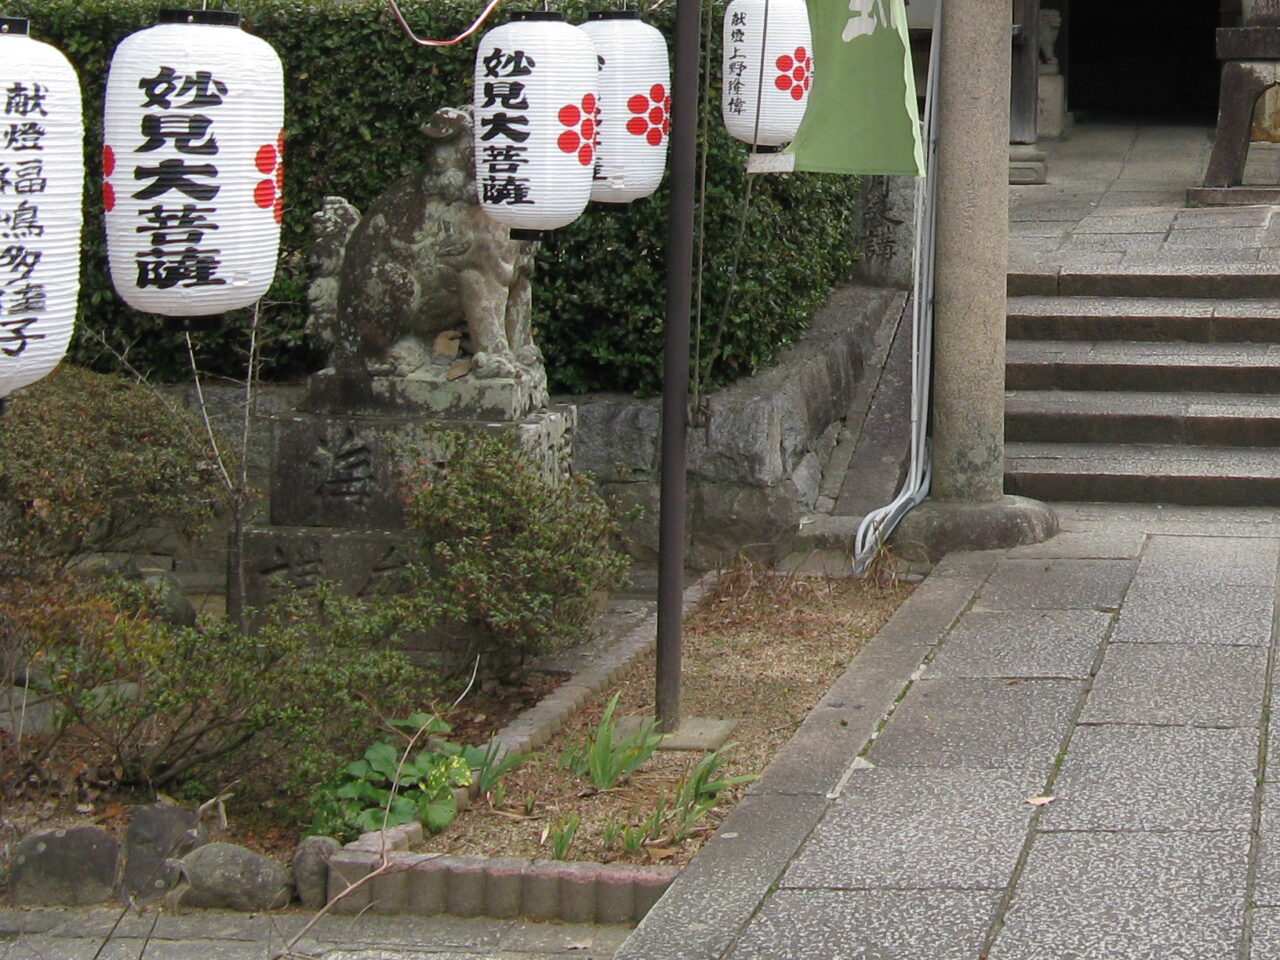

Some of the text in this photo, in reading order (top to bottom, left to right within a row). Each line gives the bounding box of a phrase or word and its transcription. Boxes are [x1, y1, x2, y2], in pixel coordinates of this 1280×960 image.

[130, 66, 229, 289] 妙見大菩薩
[480, 47, 536, 205] 妙見大菩薩
